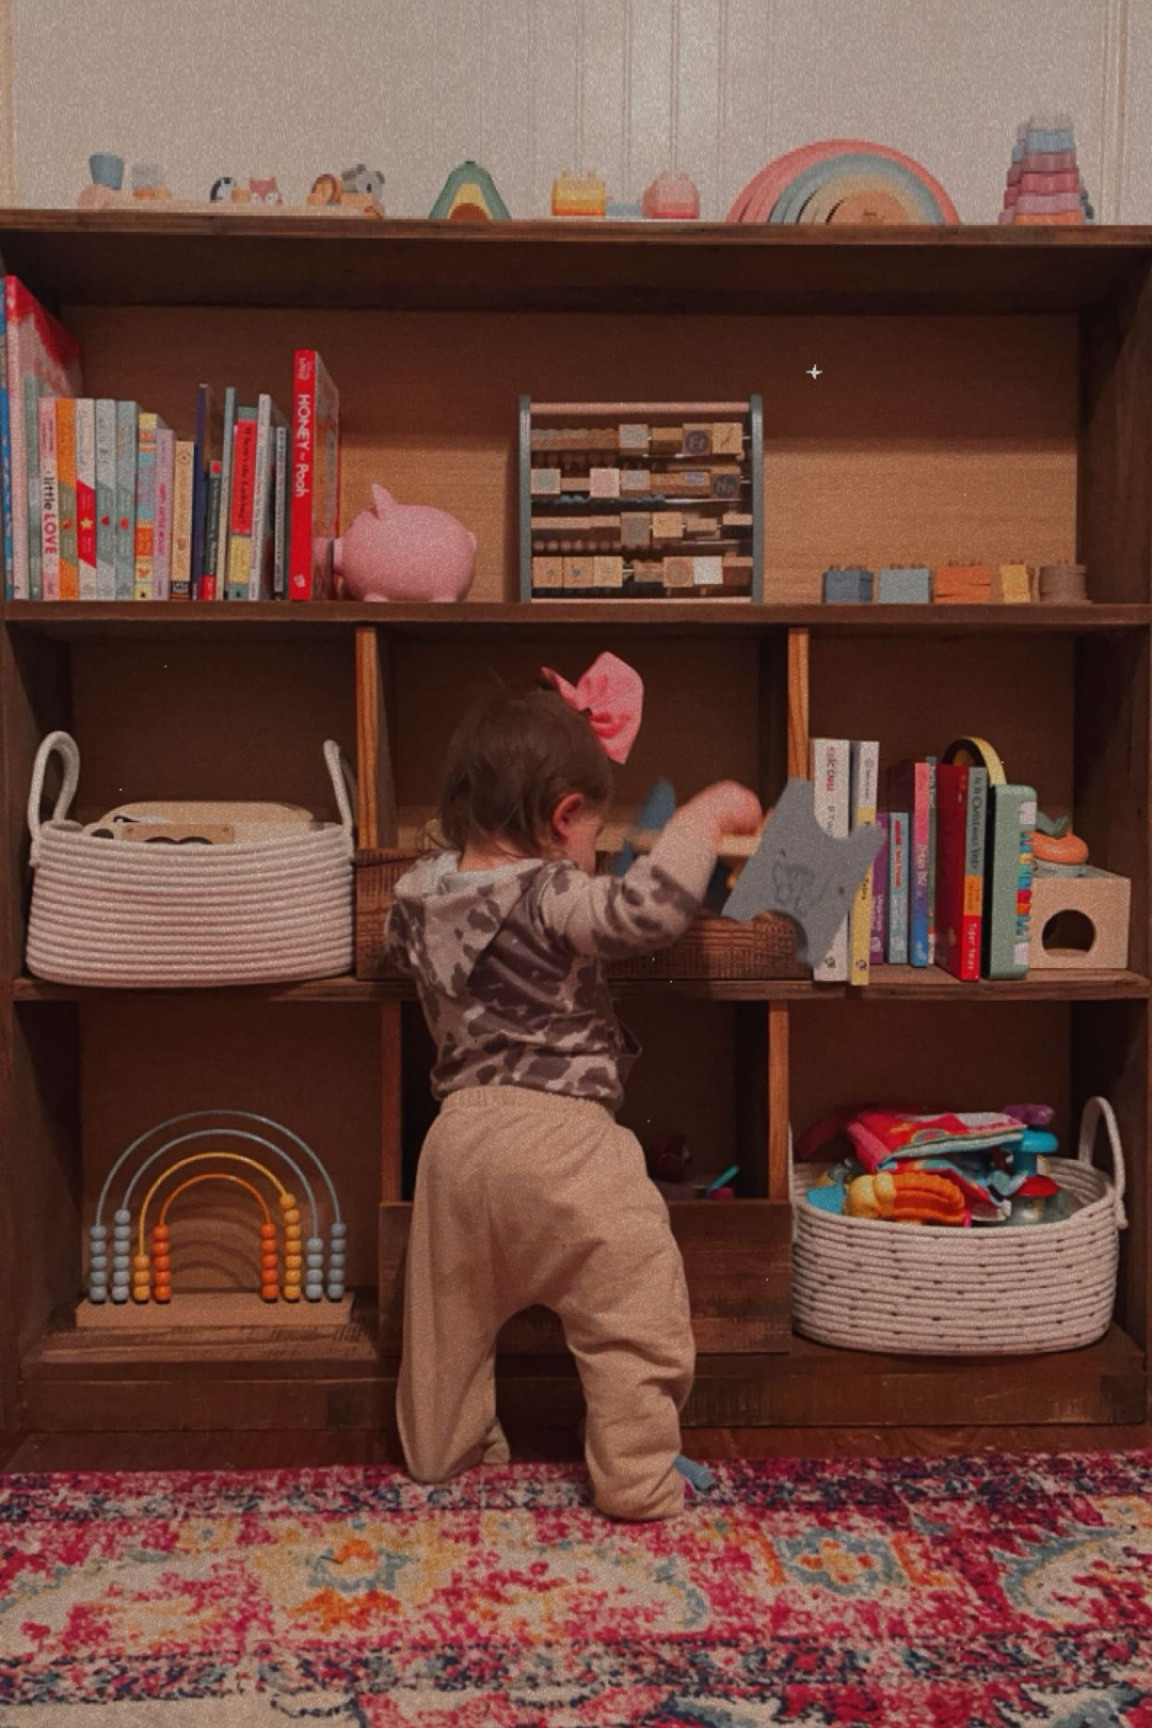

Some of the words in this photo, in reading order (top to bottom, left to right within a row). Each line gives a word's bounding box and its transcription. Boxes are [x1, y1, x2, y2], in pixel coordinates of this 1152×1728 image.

[297, 394, 310, 450] HONEY
[43, 477, 56, 510] little
[295, 463, 309, 497] Pooh
[44, 513, 57, 554] LOVE
[971, 797, 982, 846] Christmas
